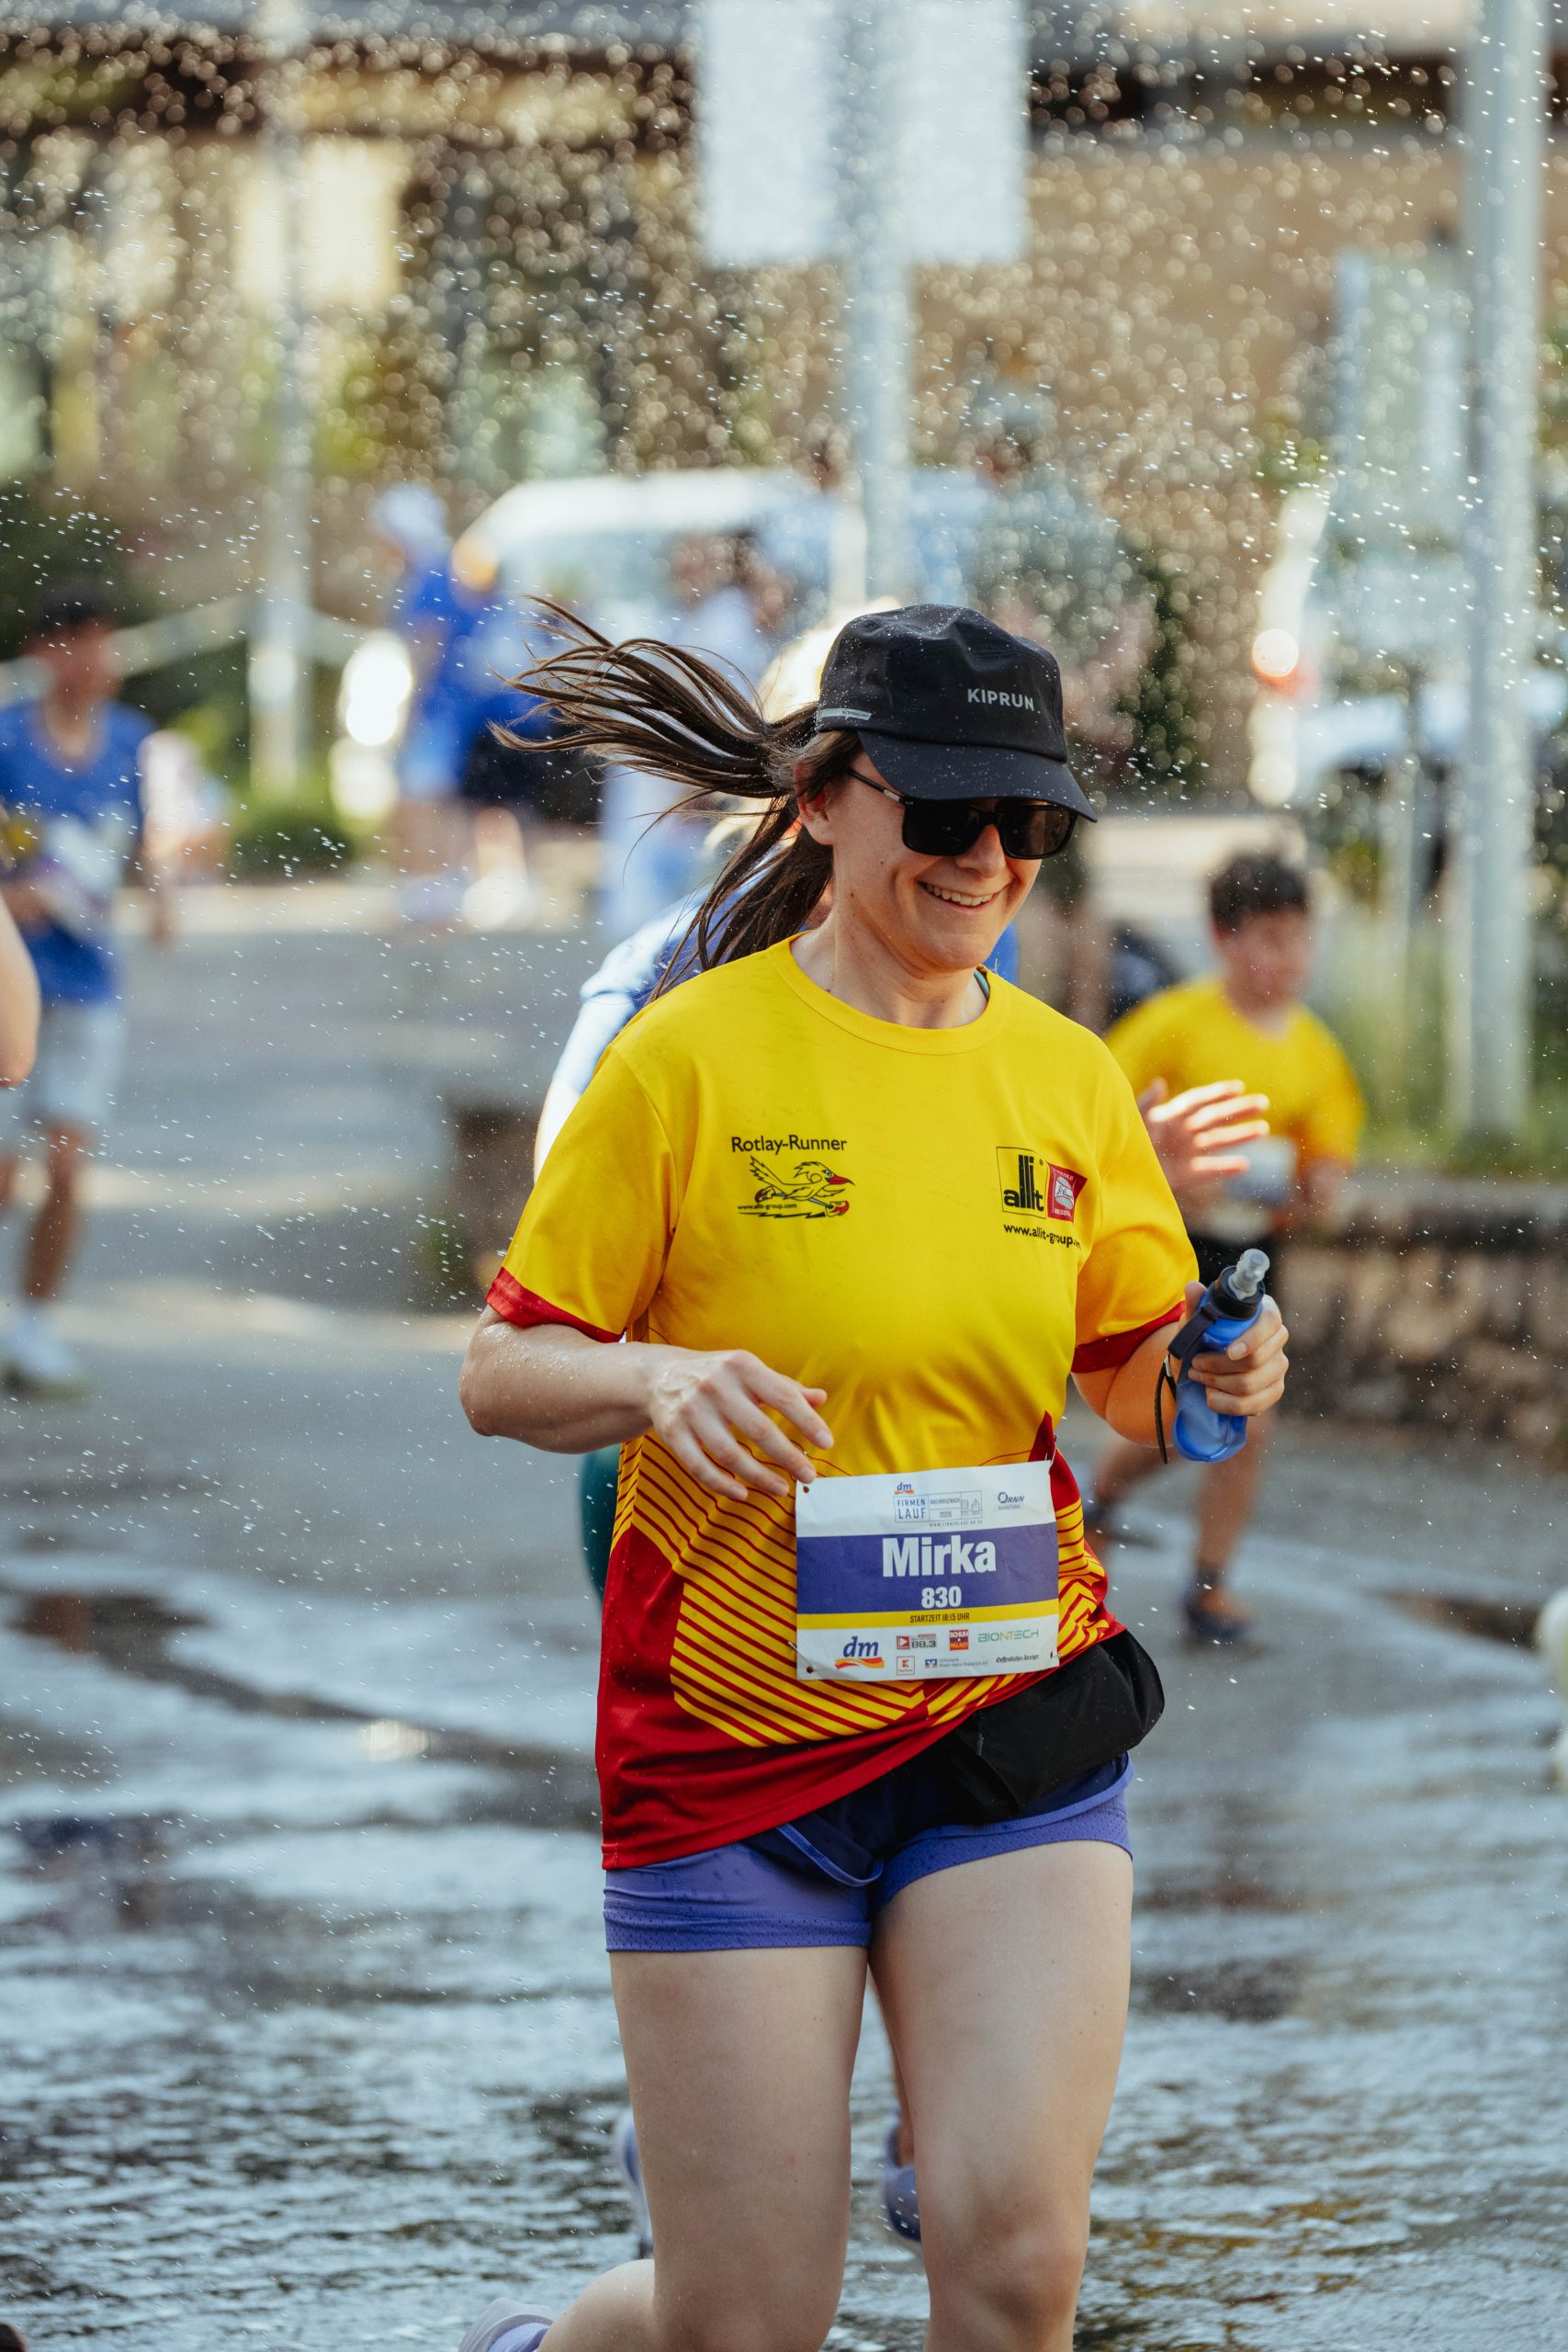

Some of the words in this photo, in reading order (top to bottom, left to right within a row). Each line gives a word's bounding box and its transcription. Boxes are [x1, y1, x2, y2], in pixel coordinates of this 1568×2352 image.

[967, 688, 1034, 711] KIPRUN
[731, 1135, 847, 1155] Rotlay-Runner
[1003, 1154, 1044, 1212] allit
[897, 1482, 912, 1491] dm
[897, 1498, 926, 1507] FIRMEN
[897, 1507, 927, 1520] LAUF
[883, 1534, 997, 1577] Mirka
[921, 1586, 962, 1608] 830
[909, 1613, 941, 1623] STARTZEIT
[942, 1612, 956, 1622] 18:15
[957, 1612, 970, 1621] UHR
[911, 1640, 936, 1648] 88.3
[978, 1628, 1039, 1643] BIONTECH
[842, 1635, 879, 1657] dm
